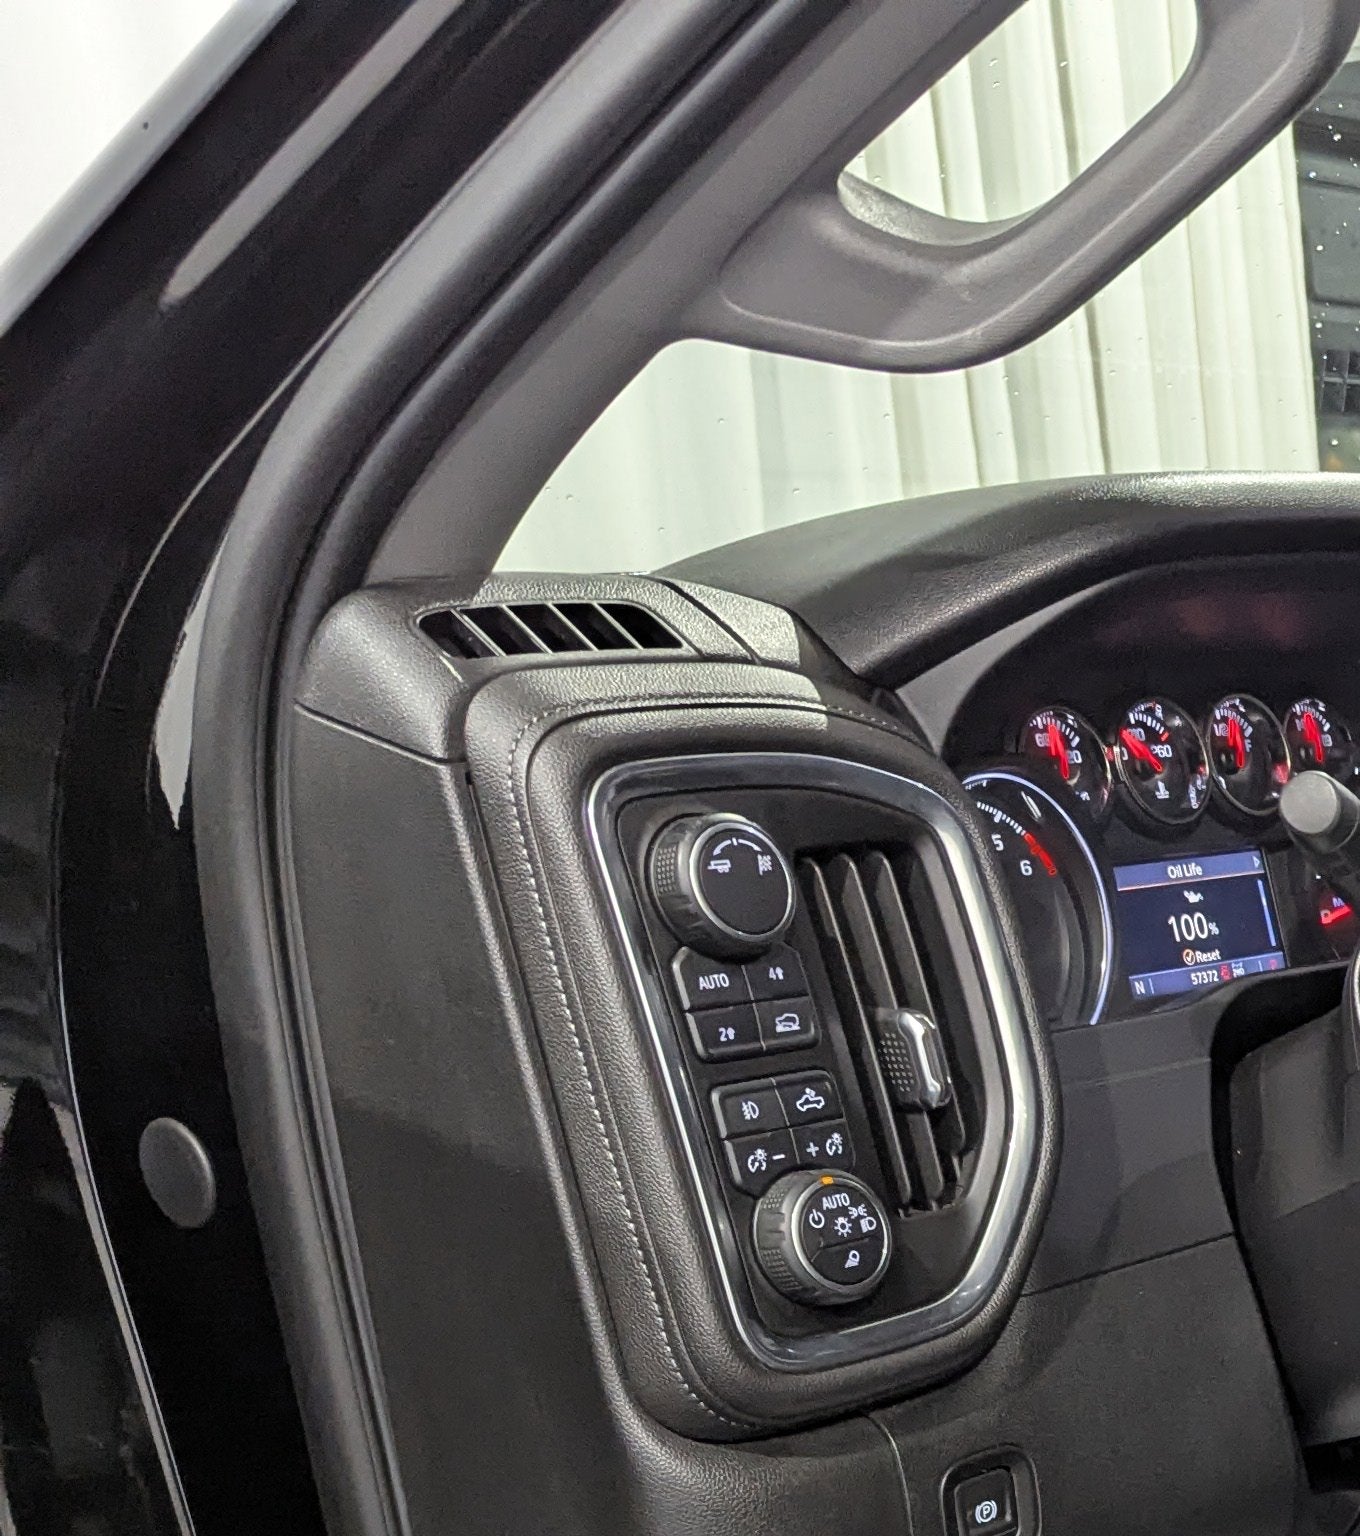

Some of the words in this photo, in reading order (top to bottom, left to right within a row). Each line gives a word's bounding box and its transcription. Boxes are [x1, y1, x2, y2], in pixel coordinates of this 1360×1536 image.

[991, 834, 1004, 851] 5
[1020, 860, 1033, 876] 6
[1167, 864, 1182, 879] Oil
[1183, 862, 1203, 877] Life
[1195, 949, 1221, 963] Reset
[698, 973, 730, 990] AUTO
[1190, 969, 1219, 985] 57372
[1134, 981, 1146, 995] N
[822, 1192, 850, 1210] AUTO
